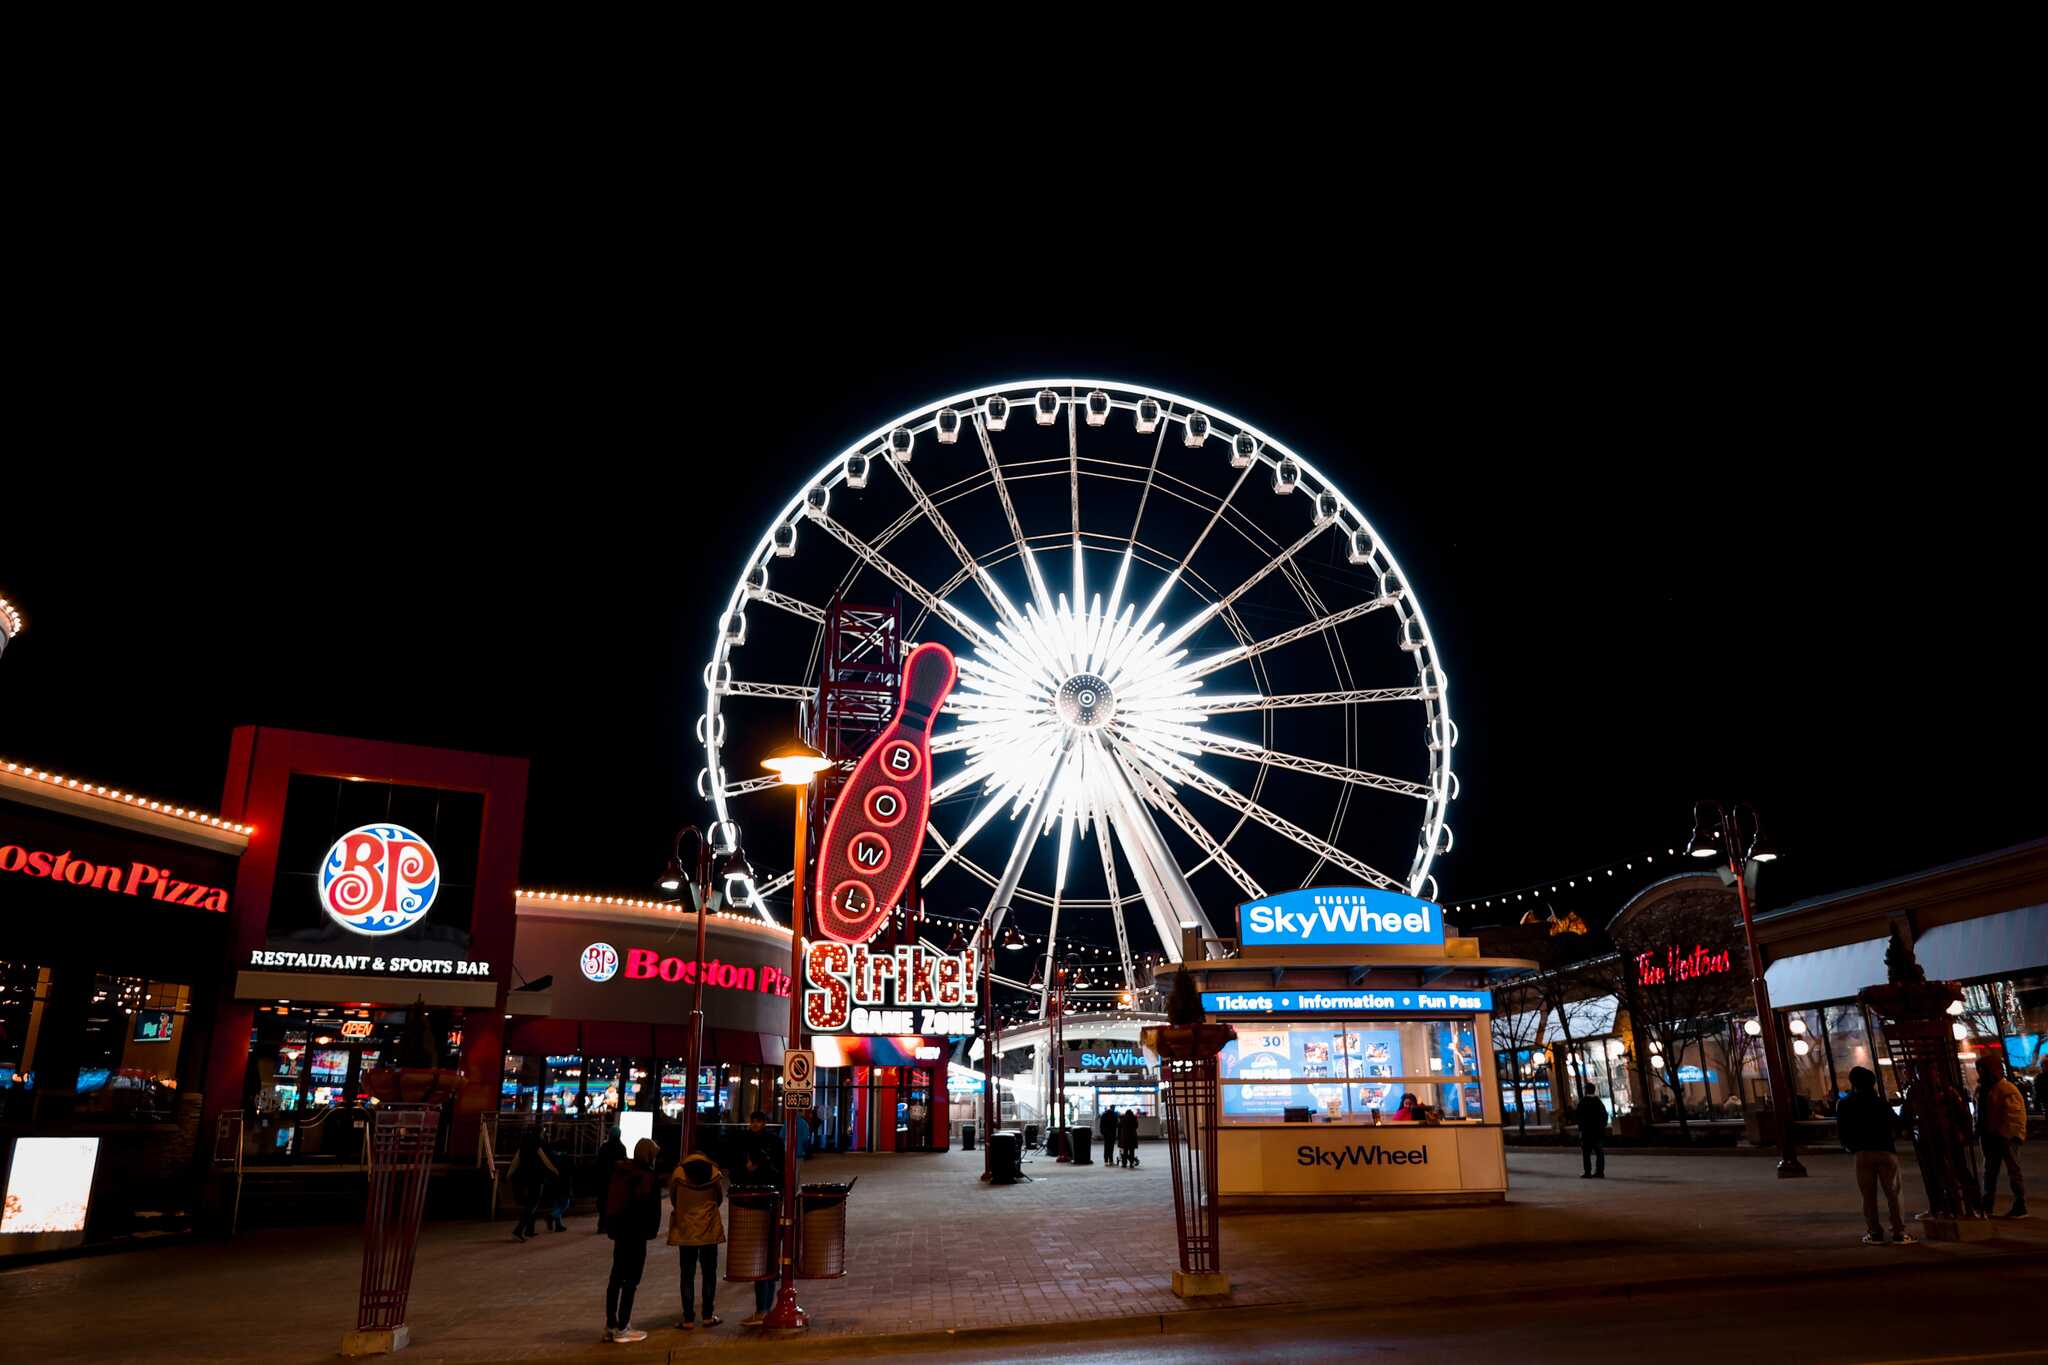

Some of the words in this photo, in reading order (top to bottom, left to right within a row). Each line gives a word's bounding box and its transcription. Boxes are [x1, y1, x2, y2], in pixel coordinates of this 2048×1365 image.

[845, 748, 910, 912] BOWL
[124, 862, 229, 913] Pizza
[328, 833, 435, 916] BP
[1250, 905, 1431, 938] SkyWheel
[251, 950, 370, 970] RESTAURANT
[372, 956, 385, 970] &
[389, 957, 452, 973] SPORTS
[456, 961, 490, 975] BAR
[624, 948, 755, 991] Boston
[804, 939, 979, 1032] Strike!
[1216, 996, 1273, 1010] Tickets
[1299, 994, 1395, 1009] Information
[1418, 994, 1446, 1008] Fun
[1449, 995, 1482, 1009] Pass
[341, 1021, 373, 1036] OPEN
[850, 1007, 914, 1035] GAME
[920, 1009, 976, 1035] ZONE
[1263, 1035, 1281, 1047] 30
[1081, 1052, 1162, 1069] SkyWhel
[1297, 1145, 1428, 1169] SkyWheel
